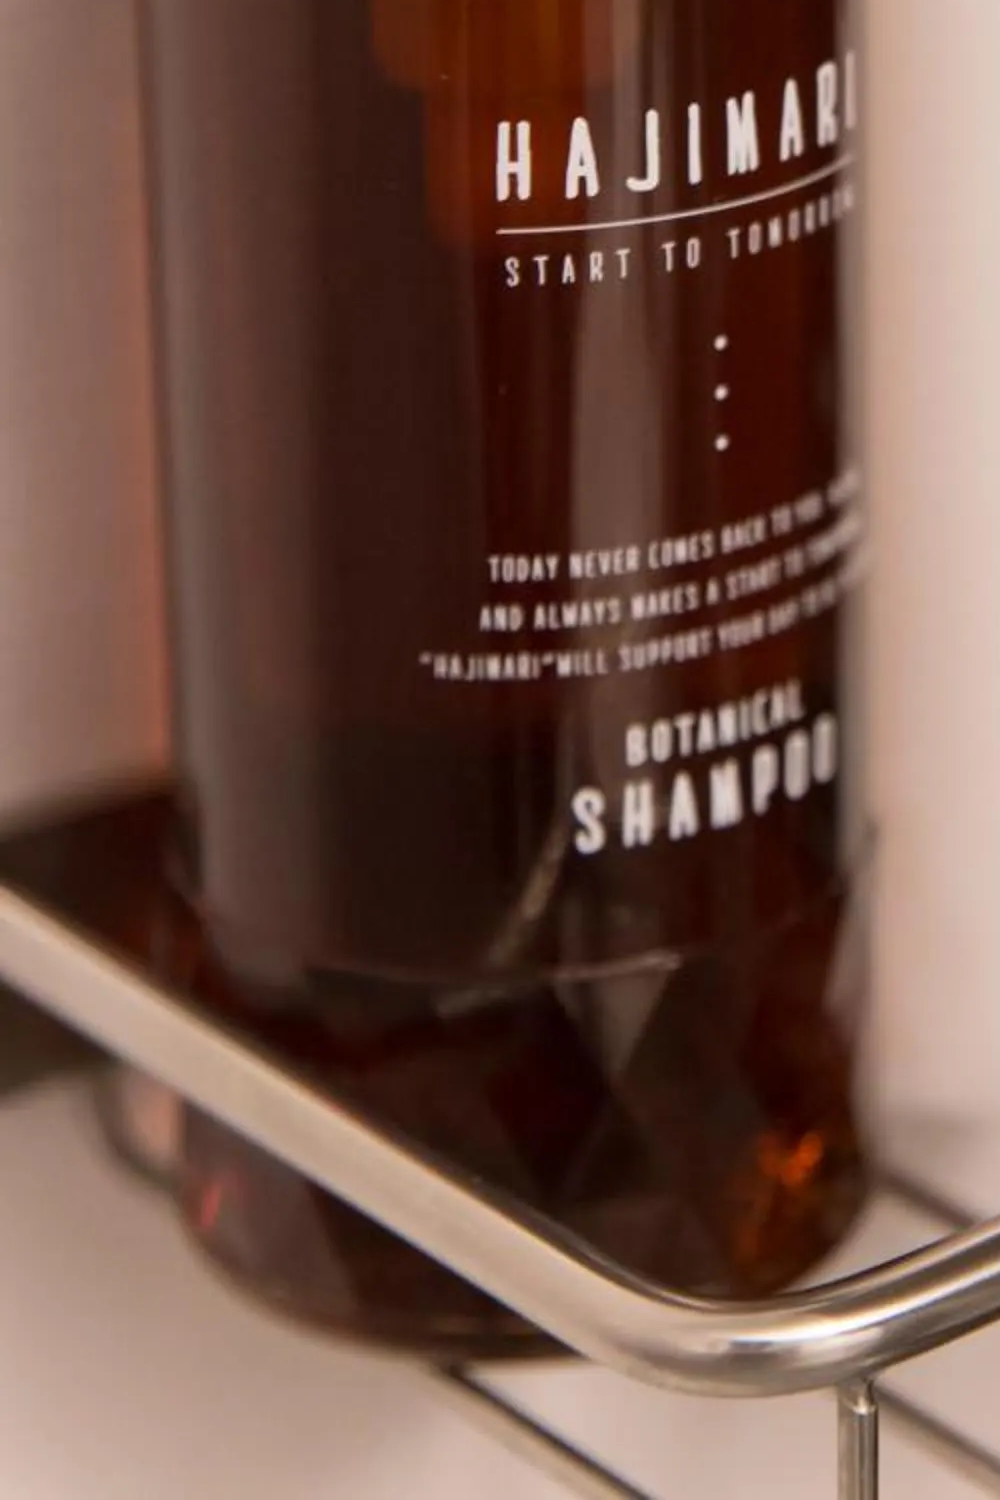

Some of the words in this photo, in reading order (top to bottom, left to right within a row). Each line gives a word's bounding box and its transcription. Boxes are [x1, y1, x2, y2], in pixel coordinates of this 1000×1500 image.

[497, 50, 857, 201] HAJIMARI
[504, 247, 631, 287] START
[660, 236, 701, 272] TO
[487, 554, 560, 583] TODAY
[569, 544, 639, 579] NEVER
[648, 529, 714, 570] COMES
[479, 603, 525, 632] AND
[533, 596, 621, 631] ALWAYS
[631, 581, 698, 620] MAKES
[705, 575, 720, 606] A
[617, 625, 713, 673] SUPPORT
[625, 676, 806, 768] BOTANICAL
[570, 711, 838, 856] SHAMPOO
